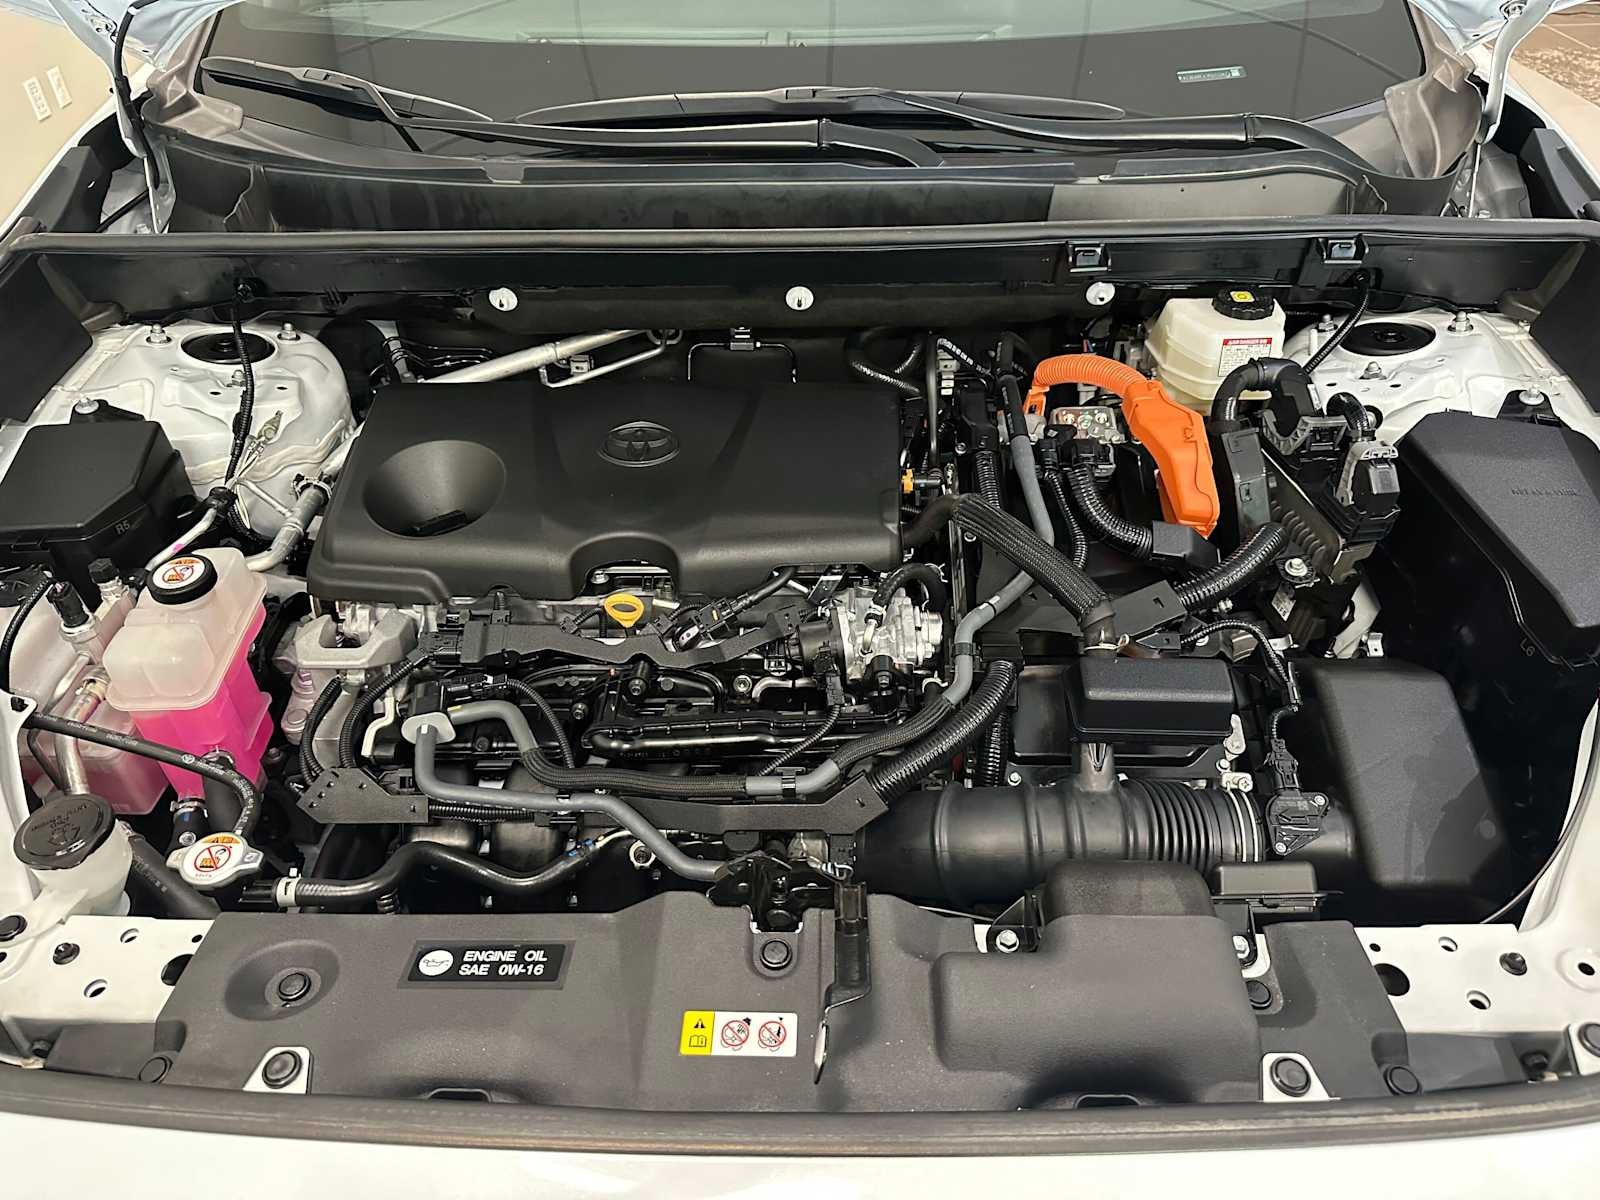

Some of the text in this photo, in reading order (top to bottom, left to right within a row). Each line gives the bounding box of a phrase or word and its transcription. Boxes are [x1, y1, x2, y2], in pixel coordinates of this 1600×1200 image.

[1519, 637, 1536, 656] L6
[463, 950, 547, 961] ENGINE OIL
[459, 964, 544, 975] SAE 0W-16
